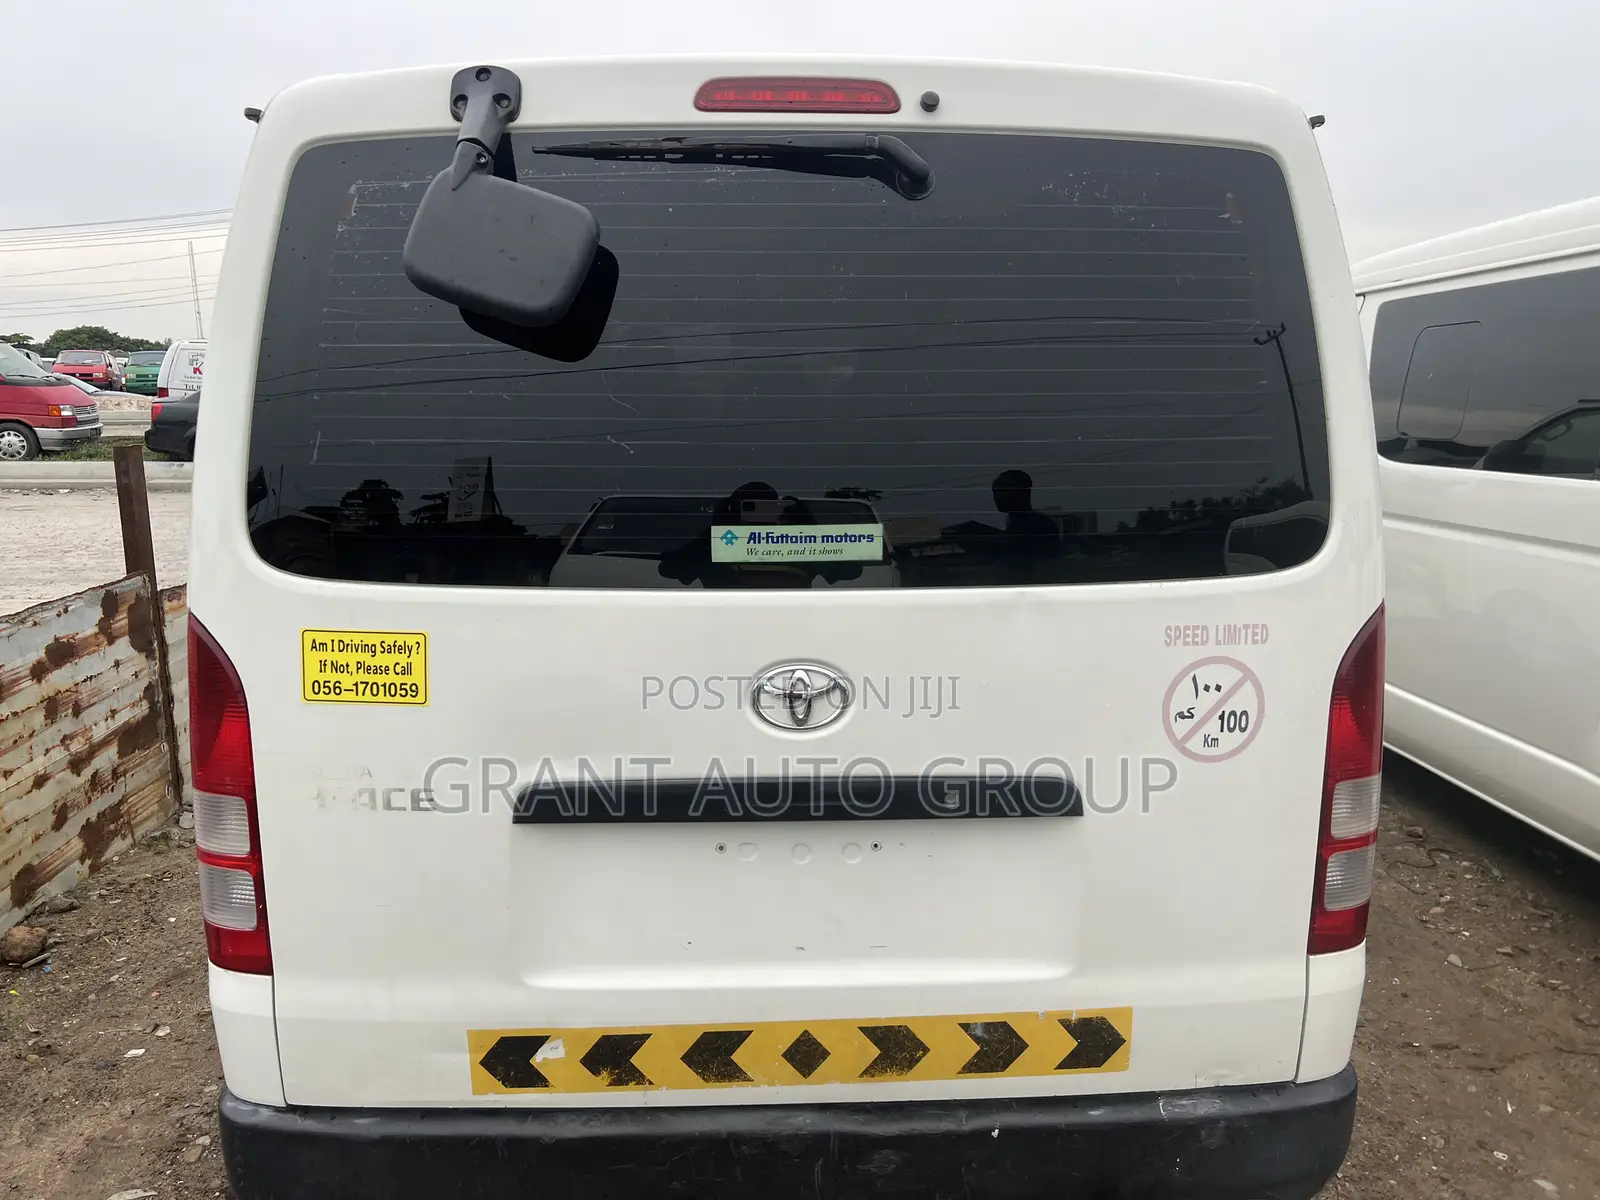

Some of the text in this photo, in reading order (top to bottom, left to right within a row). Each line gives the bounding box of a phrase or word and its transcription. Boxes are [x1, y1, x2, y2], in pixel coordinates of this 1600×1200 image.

[821, 532, 875, 543] motors
[746, 546, 844, 557] We care, and it shows
[1164, 623, 1269, 647] SPEED LIMITED
[310, 638, 328, 652] Am
[330, 639, 335, 652] I
[338, 639, 377, 658] Driving
[380, 640, 414, 658] Safely
[319, 659, 413, 676] If Not, Please Call
[311, 679, 419, 698] 056-1701059
[1218, 709, 1250, 733] 100
[1203, 733, 1219, 748] Km
